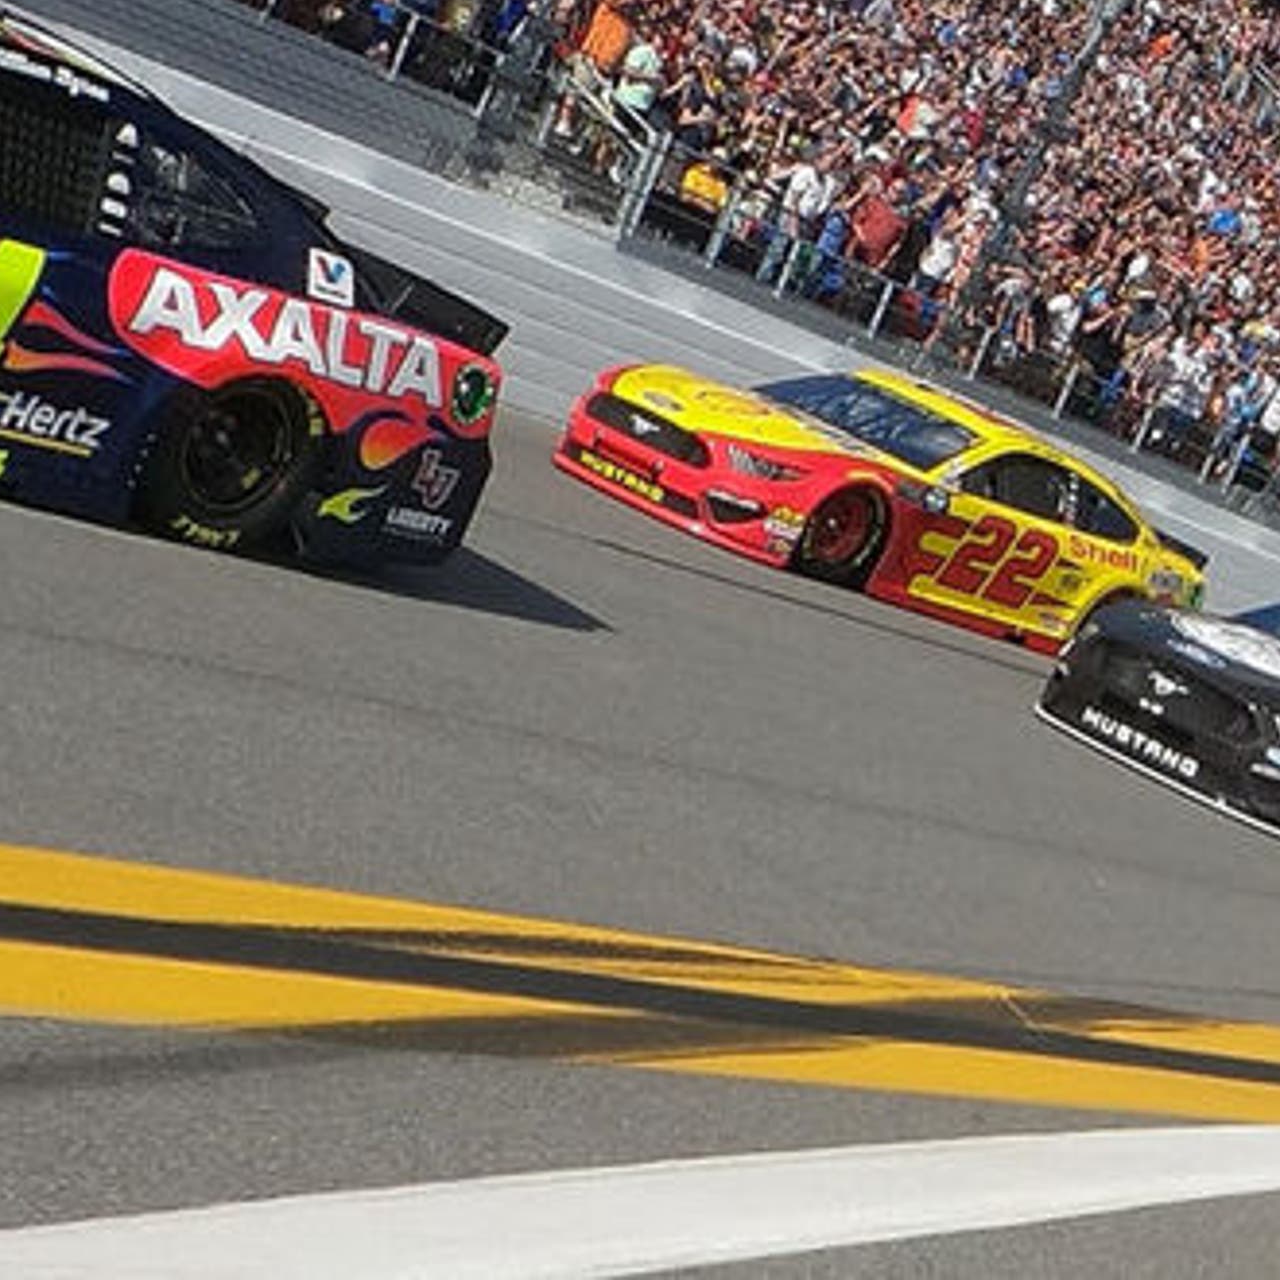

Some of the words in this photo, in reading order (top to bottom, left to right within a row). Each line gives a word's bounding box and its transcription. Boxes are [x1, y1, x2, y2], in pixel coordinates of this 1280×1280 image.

[130, 268, 442, 408] AXALTA
[0, 391, 111, 449] Hertz
[933, 514, 1060, 610] 22
[1070, 533, 1138, 573] Shell
[1081, 704, 1199, 777] MUSTANG
